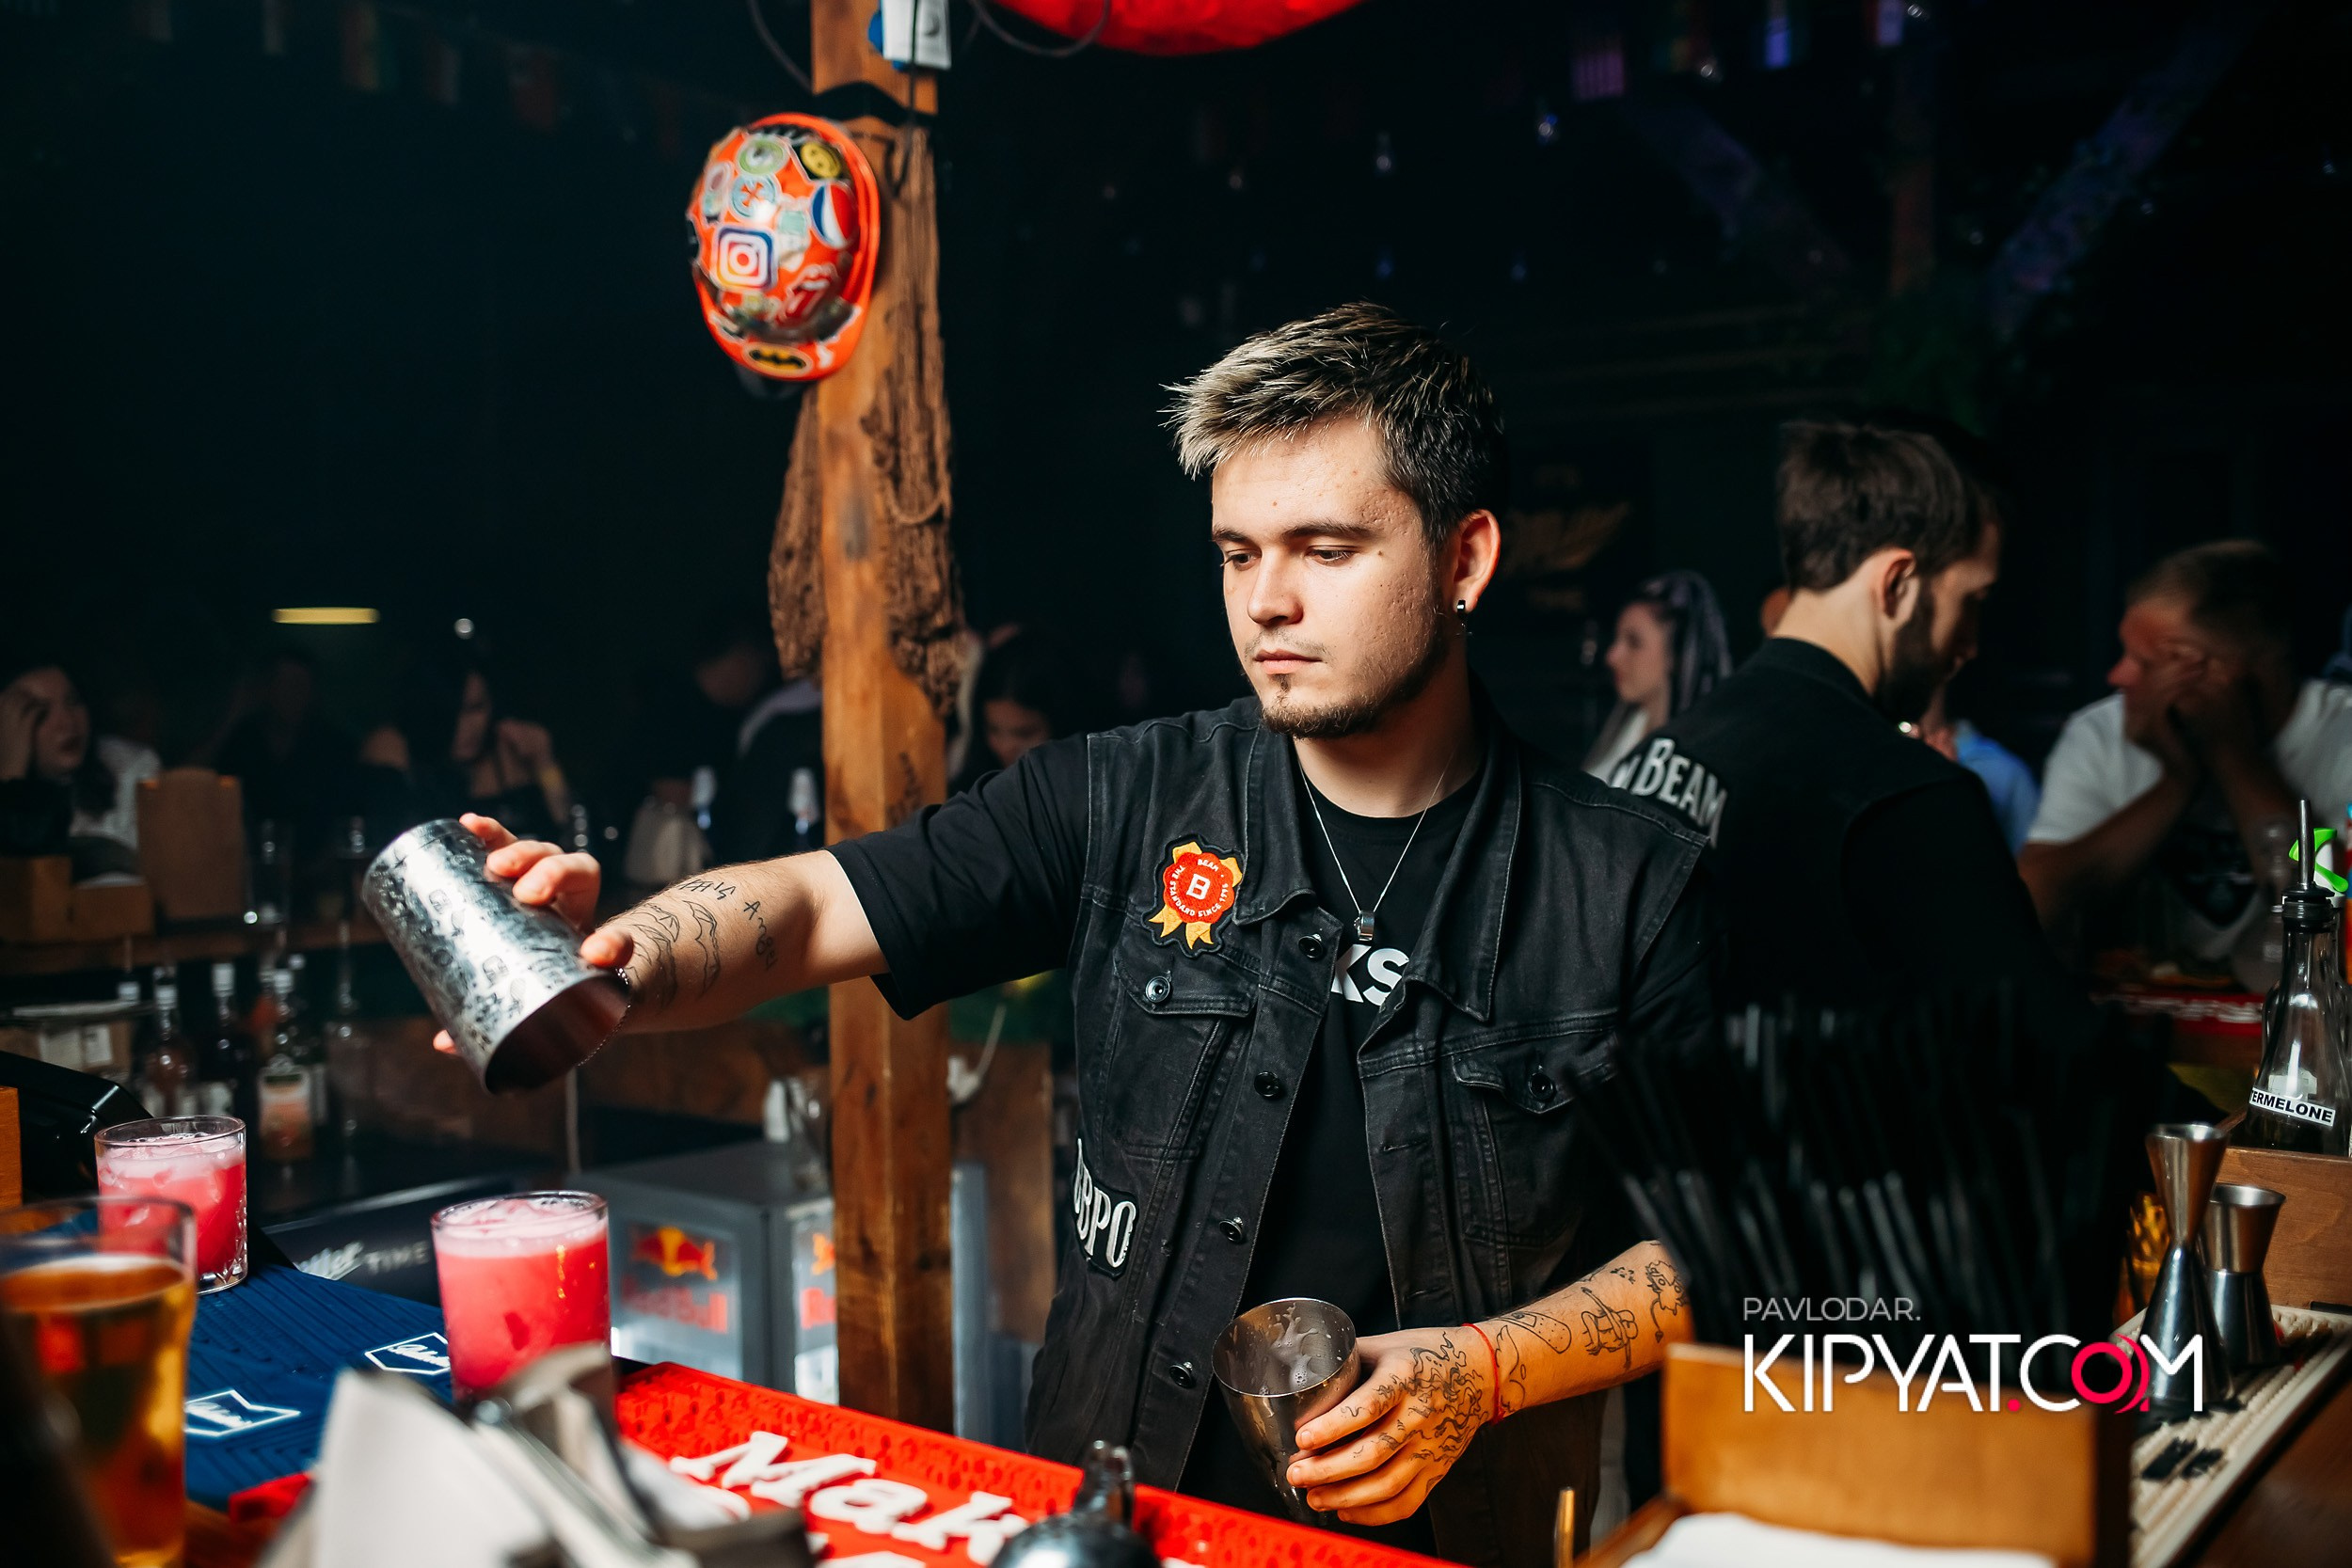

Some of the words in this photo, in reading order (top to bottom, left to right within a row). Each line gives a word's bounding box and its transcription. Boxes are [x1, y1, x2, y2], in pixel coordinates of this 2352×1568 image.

[1629, 737, 1728, 848] BEAM
[1171, 864, 1186, 880] THE
[1197, 858, 1219, 872] BEAM
[1169, 880, 1196, 917] STANDARD
[1186, 873, 1211, 900] B
[1198, 902, 1222, 918] SINCE
[2250, 1090, 2333, 1123] ERMELONE
